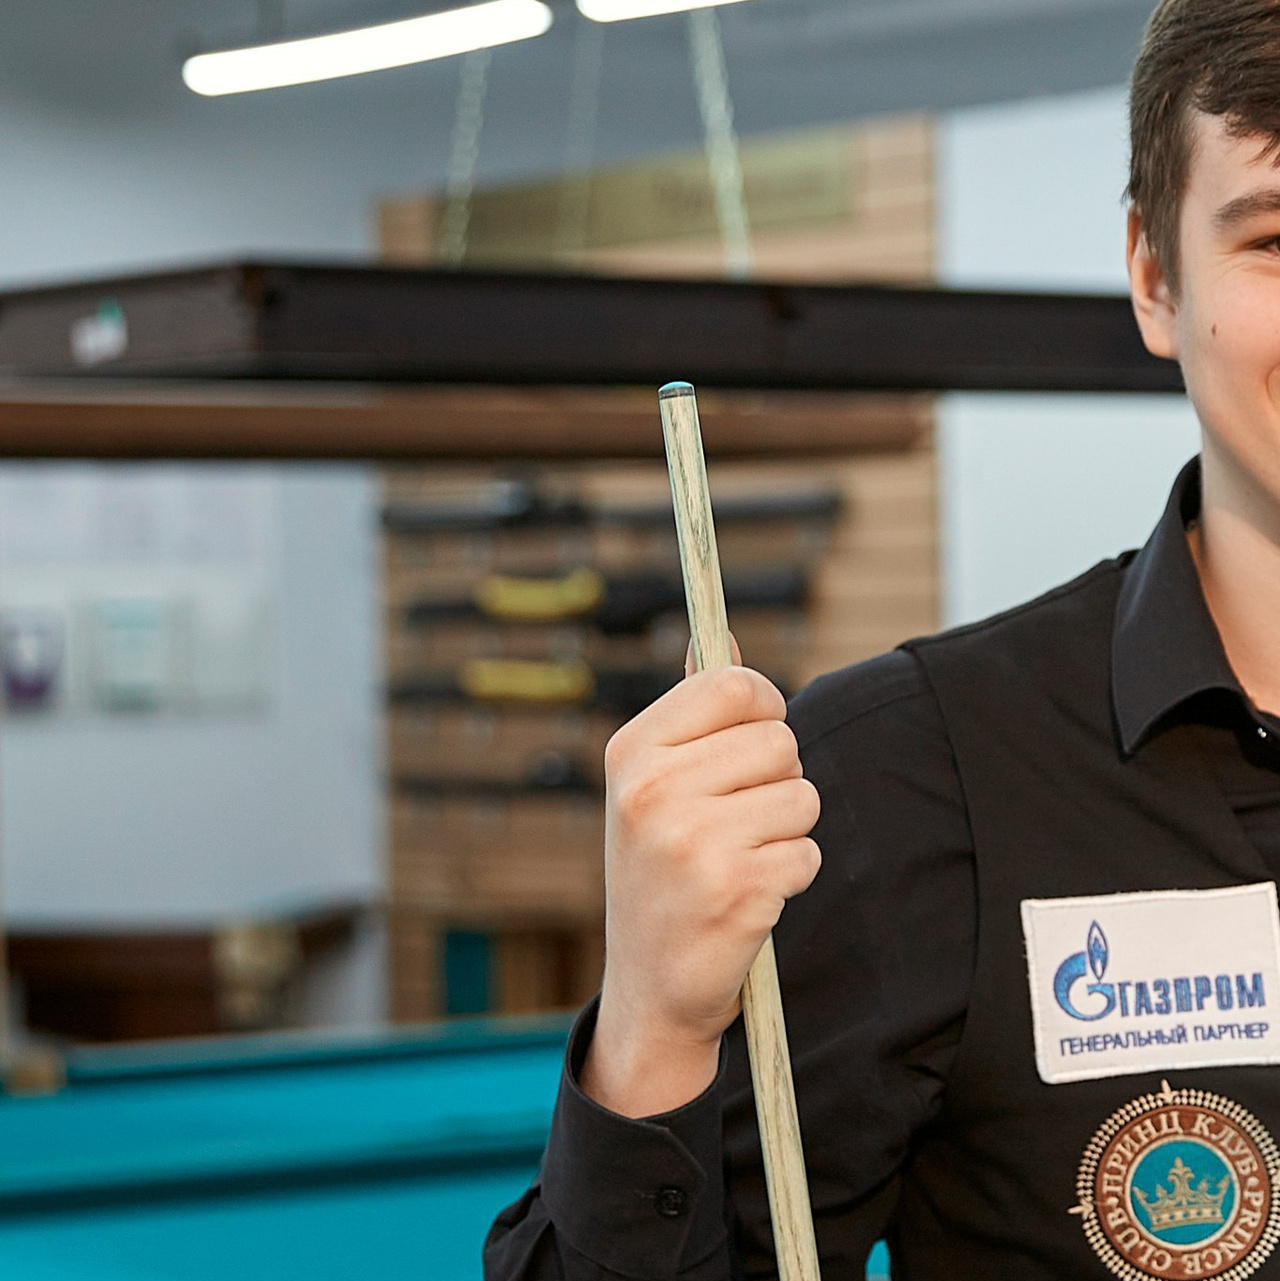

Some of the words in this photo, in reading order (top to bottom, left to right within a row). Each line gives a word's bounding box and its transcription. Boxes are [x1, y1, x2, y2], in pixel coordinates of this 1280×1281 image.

[1117, 972, 1267, 1018] ГАЗПРОМ
[1059, 1023, 1189, 1056] ГЕНЕРАЛЬНЫЙ
[1193, 1022, 1270, 1043] ПАРТНЕР
[1102, 1110, 1183, 1195] ПРИНЦ
[1190, 1111, 1259, 1176] КЛУБ
[1106, 1207, 1173, 1271] CLUB
[1183, 1190, 1265, 1275] PRINCE
